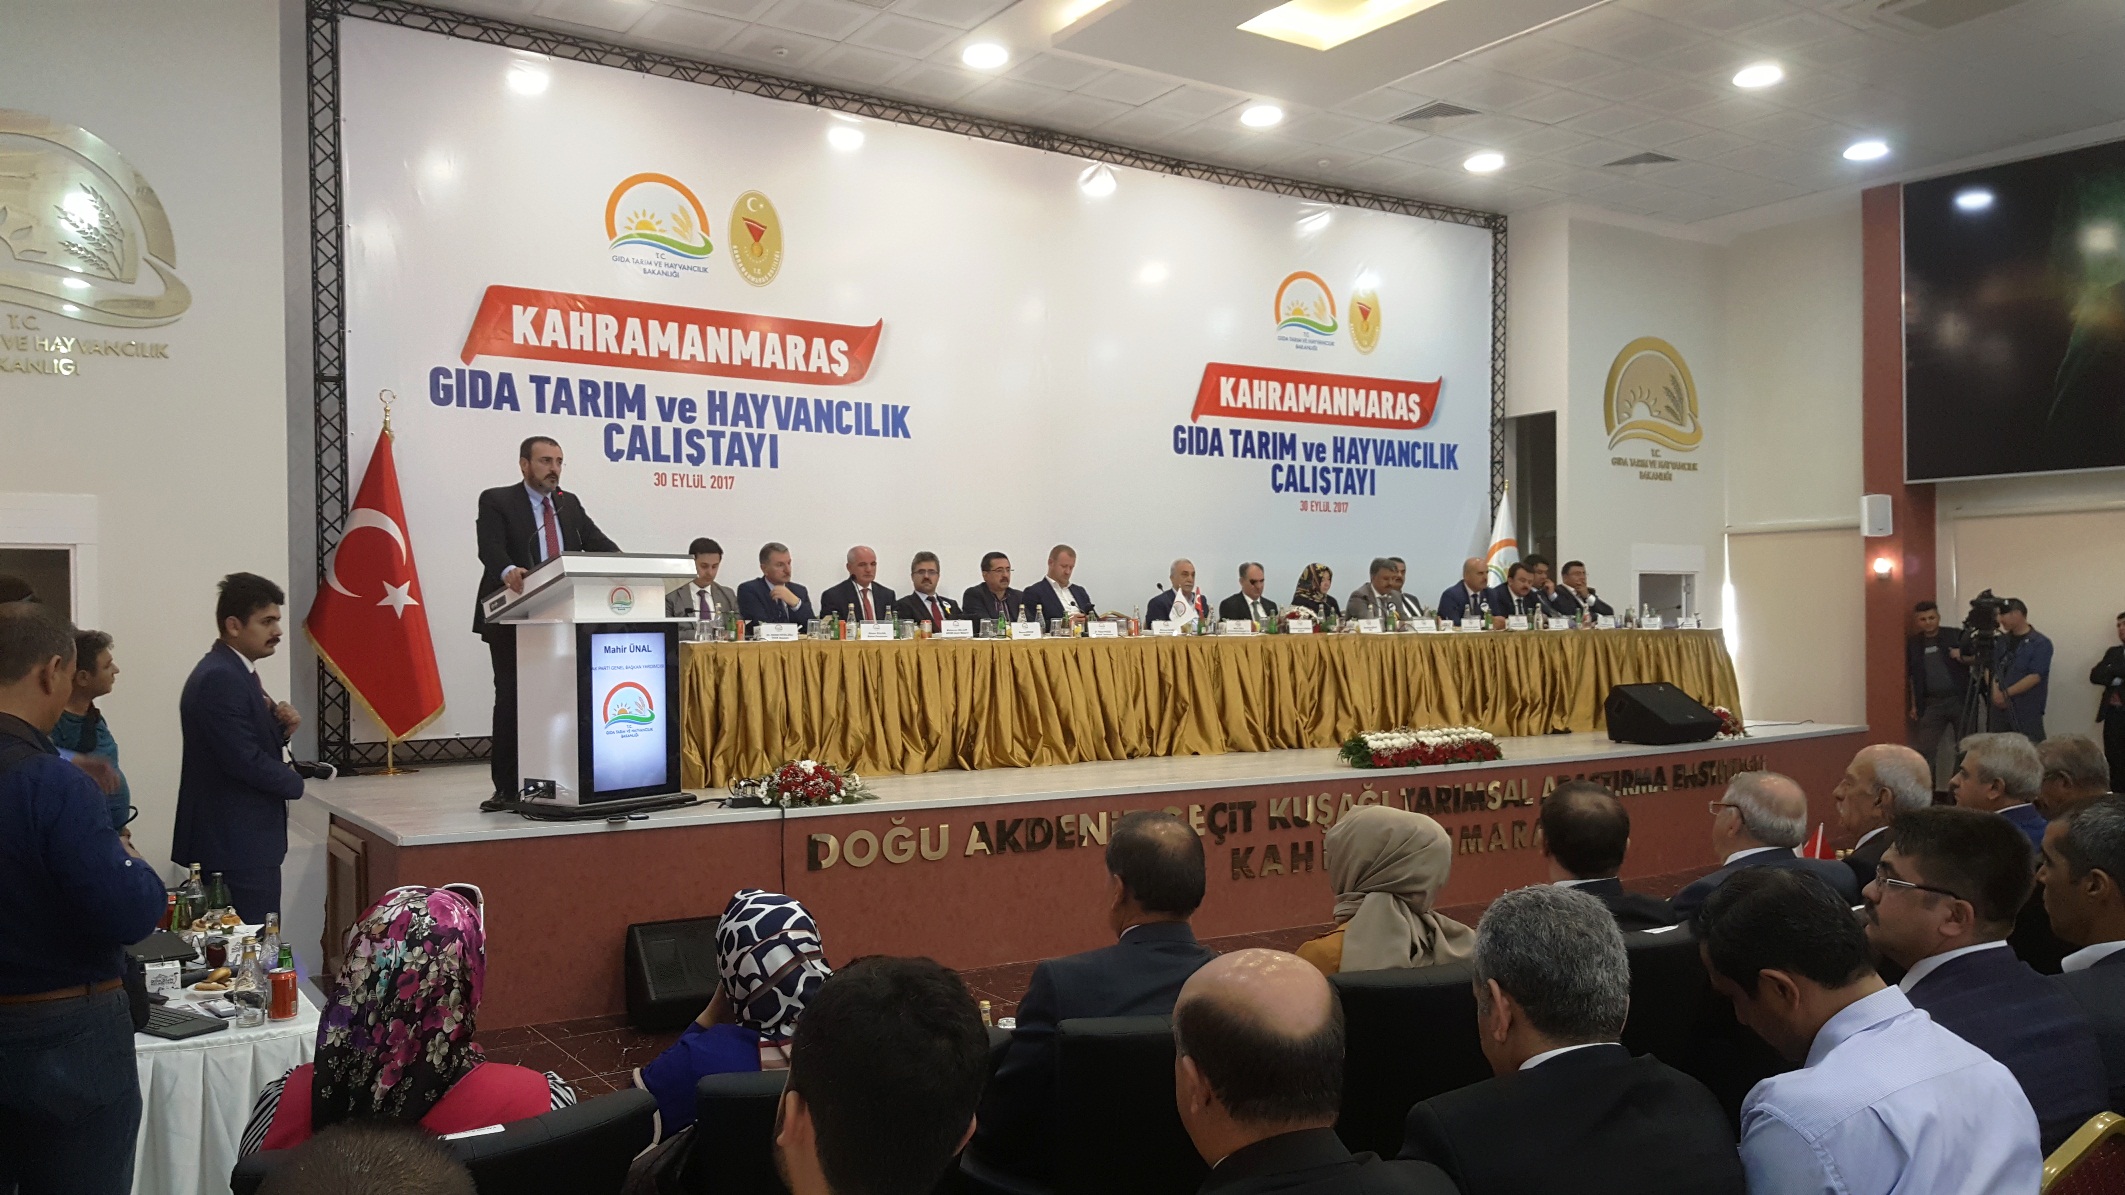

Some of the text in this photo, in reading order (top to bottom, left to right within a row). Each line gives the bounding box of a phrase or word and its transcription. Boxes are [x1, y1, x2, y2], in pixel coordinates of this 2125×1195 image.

[611, 255, 709, 274] GIDA TARIM VE HAYVANCILIK
[643, 268, 680, 278] BAKANLIĞI
[7, 314, 40, 331] T.C.
[0, 335, 28, 352] VE
[512, 304, 850, 377] KAHRAMANMARAŞ
[428, 366, 912, 440] GIDA TARIM ve HAYVANCILIK
[1219, 376, 1422, 423] KAHRAMANMARAŞ
[603, 422, 779, 470] ÇALIŞTAYI
[1173, 424, 1459, 471] GIDA TARIM ve HAYVANCILIK
[653, 472, 735, 490] 30 EYLÜL 2017
[1271, 463, 1376, 496] ÇALIŞTAYI
[1299, 500, 1349, 513] 30 EYLÜL 2017
[603, 643, 653, 654] Mahir ÜNAL
[807, 816, 950, 872] DOĞU
[963, 809, 1143, 858] AKDEN
[1400, 779, 1534, 816] TARIMSAL
